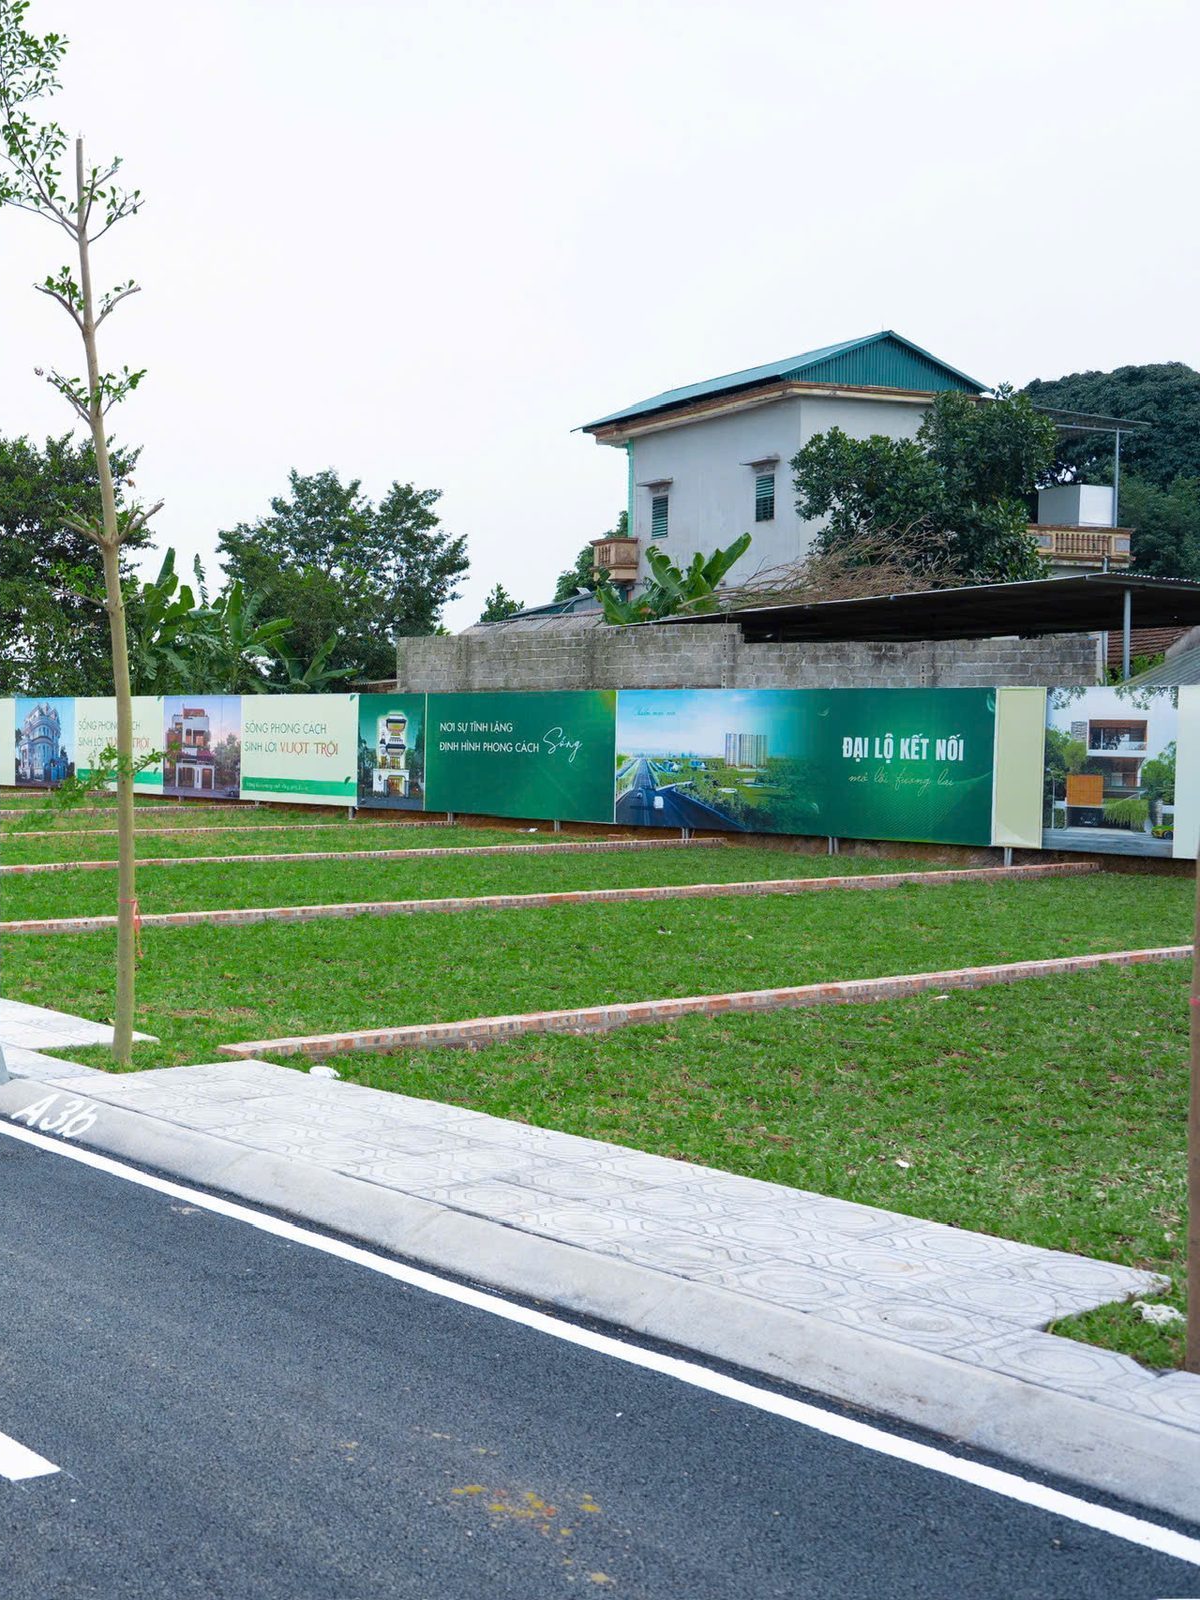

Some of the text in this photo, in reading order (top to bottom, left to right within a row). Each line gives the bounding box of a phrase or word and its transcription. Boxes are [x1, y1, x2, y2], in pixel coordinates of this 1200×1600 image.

[270, 722, 301, 735] PHONG
[457, 722, 468, 734] SỰ
[482, 741, 513, 753] PHONG
[514, 739, 539, 753] CÁCH
[842, 732, 965, 764] ĐẠI LỘ KẾT NỐI
